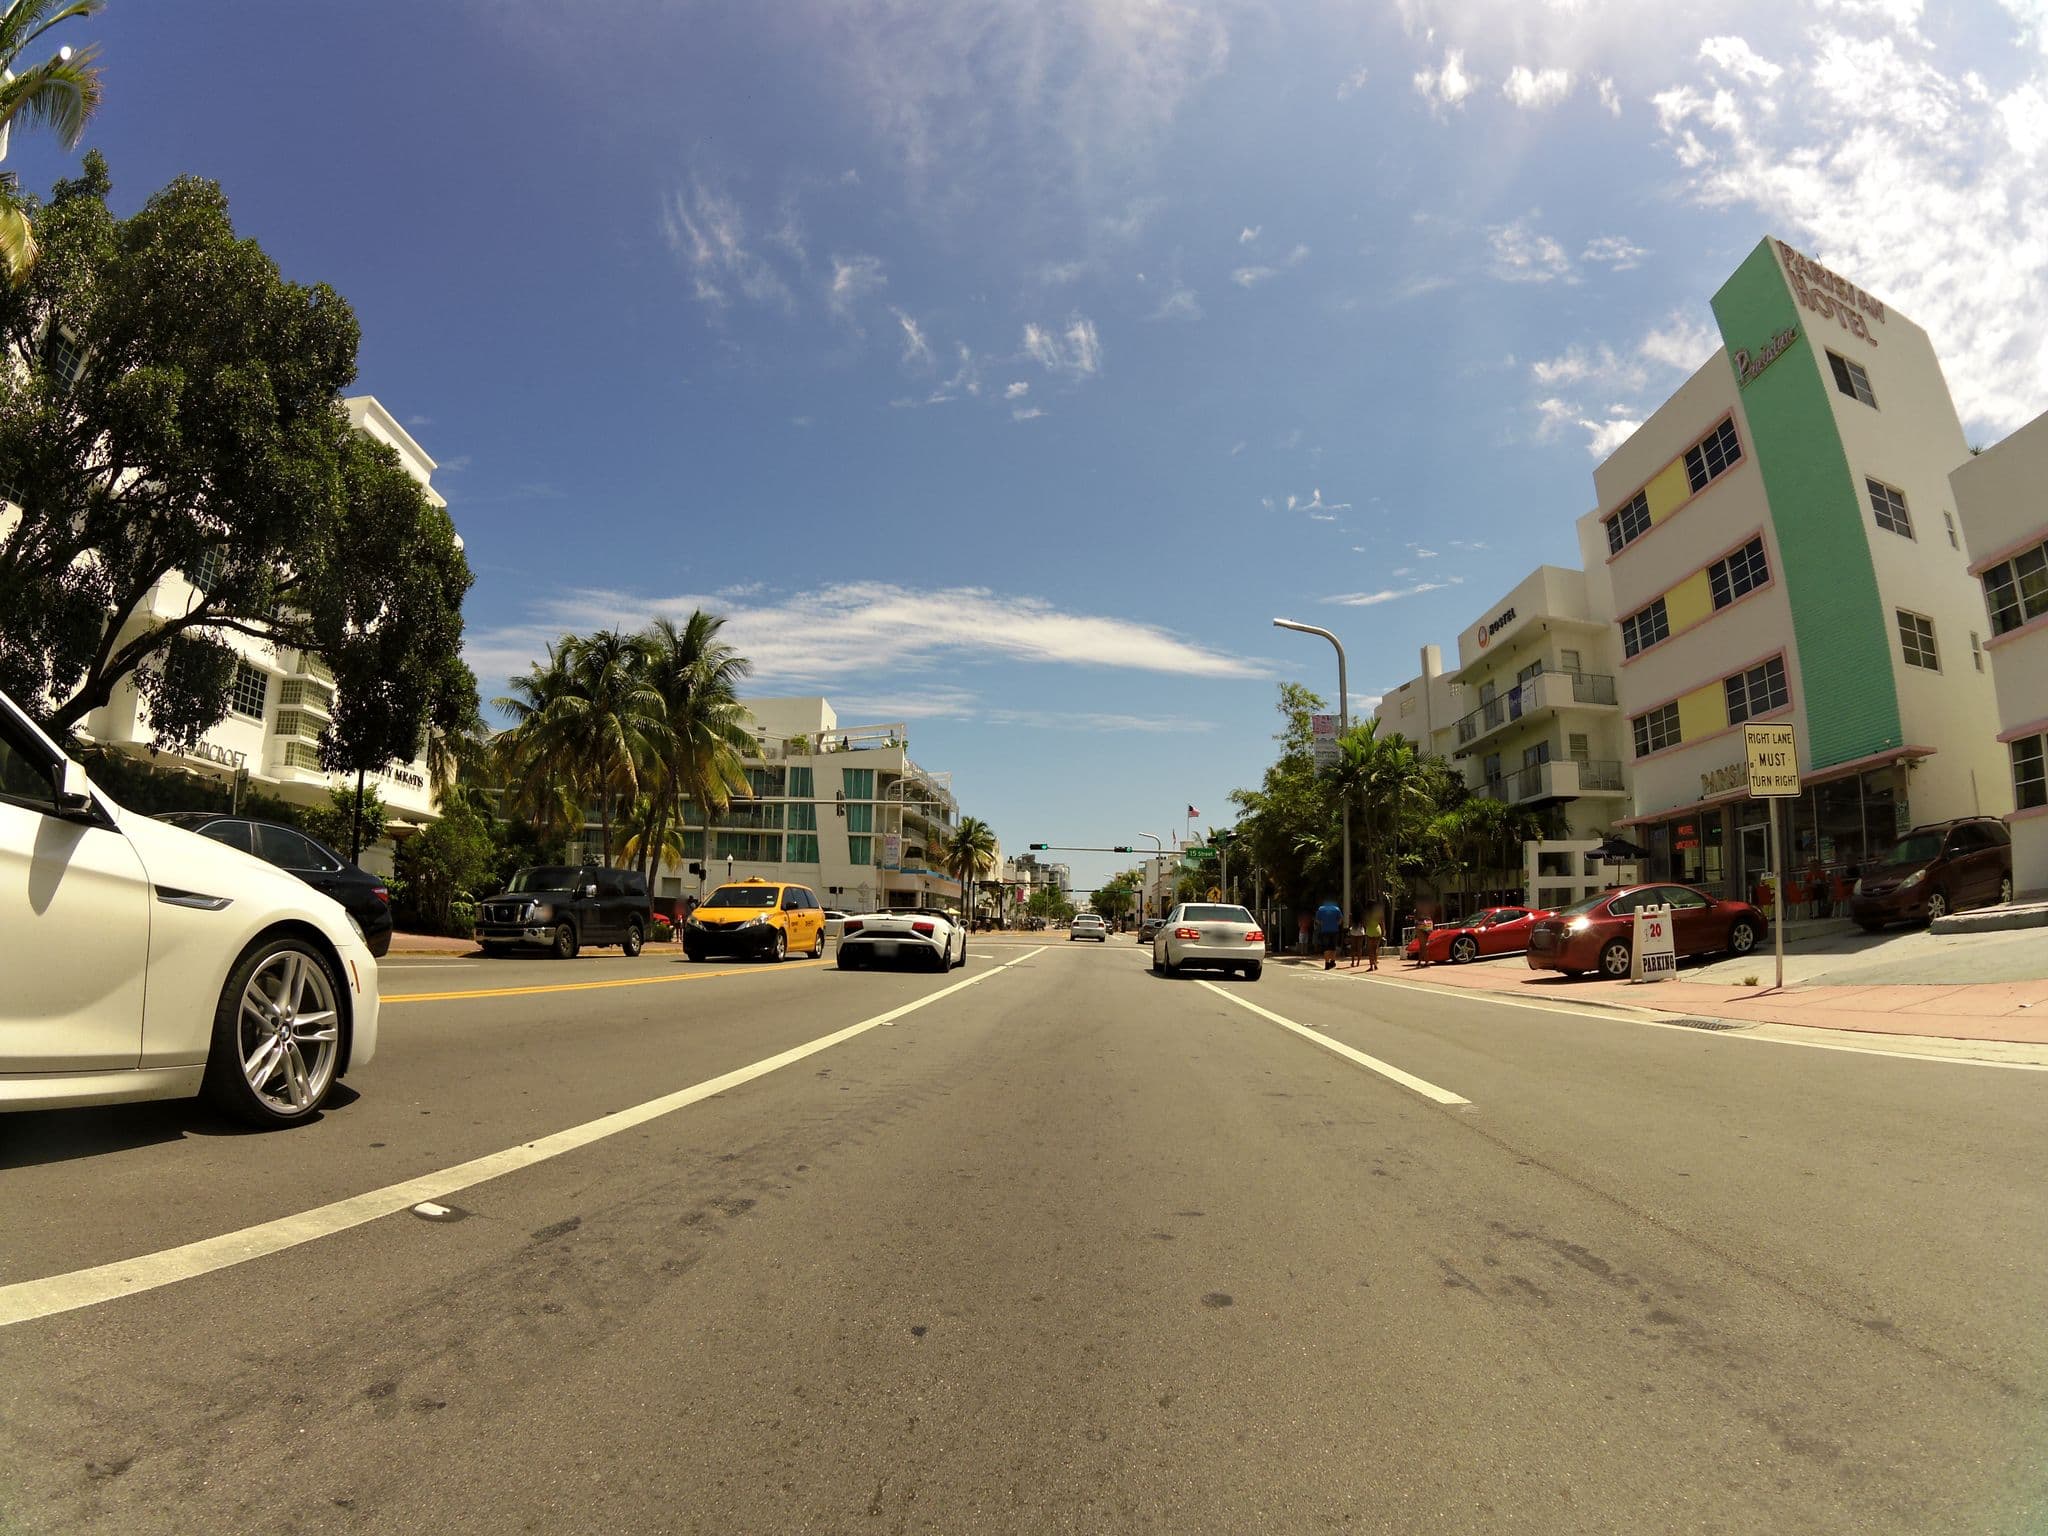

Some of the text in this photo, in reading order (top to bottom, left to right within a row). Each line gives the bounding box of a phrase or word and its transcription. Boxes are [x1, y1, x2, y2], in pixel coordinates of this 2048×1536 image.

[1788, 269, 1878, 347] HOTEL
[1489, 607, 1516, 635] HOSTEL
[1748, 733, 1793, 744] RIGHT LANE
[1759, 752, 1785, 767] MUST
[395, 768, 424, 788] MEATS
[1752, 775, 1797, 787] TURN RIGHT
[1650, 923, 1662, 938] 20
[1643, 954, 1675, 973] PARKING
